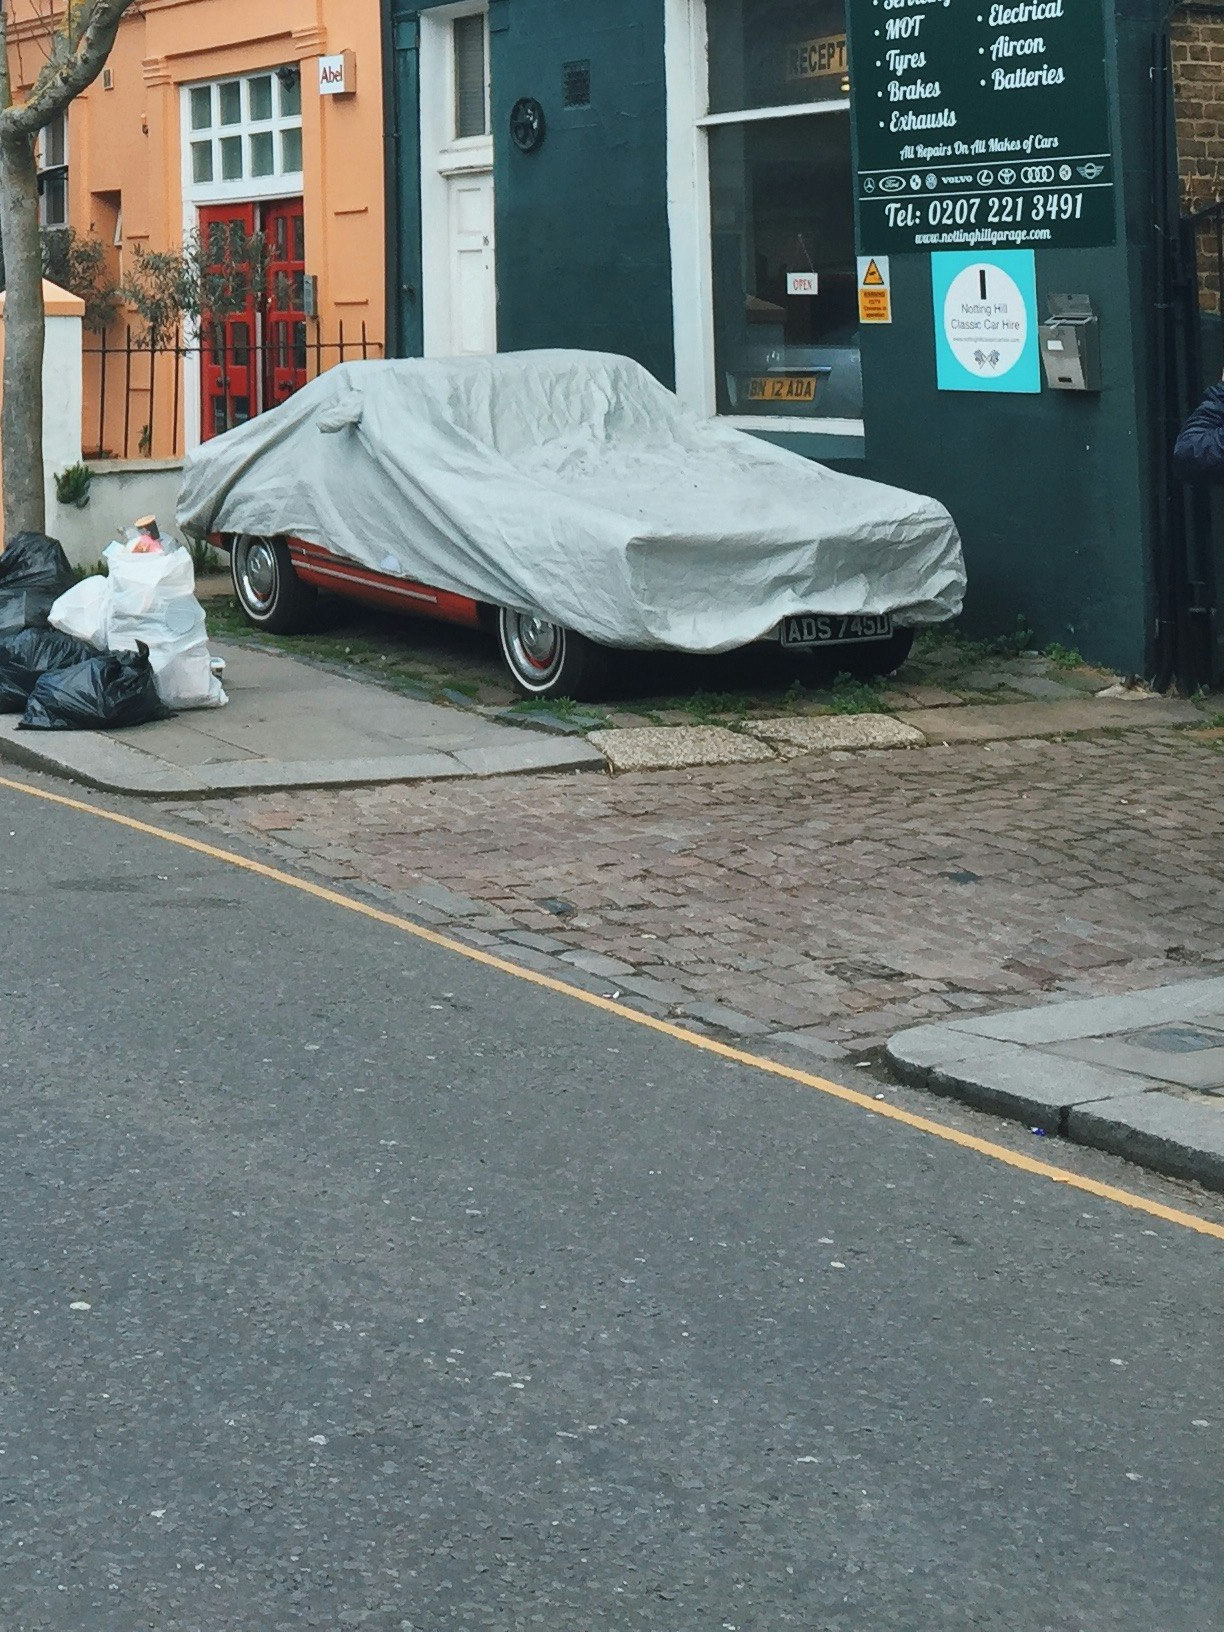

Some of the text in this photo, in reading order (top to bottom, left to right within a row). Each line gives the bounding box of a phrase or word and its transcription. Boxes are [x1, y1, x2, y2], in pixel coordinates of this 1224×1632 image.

[885, 14, 926, 40] MOT
[989, 35, 1046, 61] Aircon
[885, 49, 927, 76] Tyres
[991, 63, 1065, 91] Batteries
[887, 78, 942, 102] Brakes
[889, 107, 957, 133] Exhausts
[900, 134, 1059, 161] All Repairs On All Makes of Cars
[941, 175, 973, 185] VOLVO
[884, 193, 1083, 227] Tel: 0207 221 3491
[914, 227, 1052, 247] www.nottinghillgarage.com
[793, 278, 812, 291] OPEN
[961, 303, 1008, 317] Notting Hill
[950, 318, 1020, 330] Classic Car Hire
[786, 379, 812, 398] ADA
[788, 617, 832, 642] ADS
